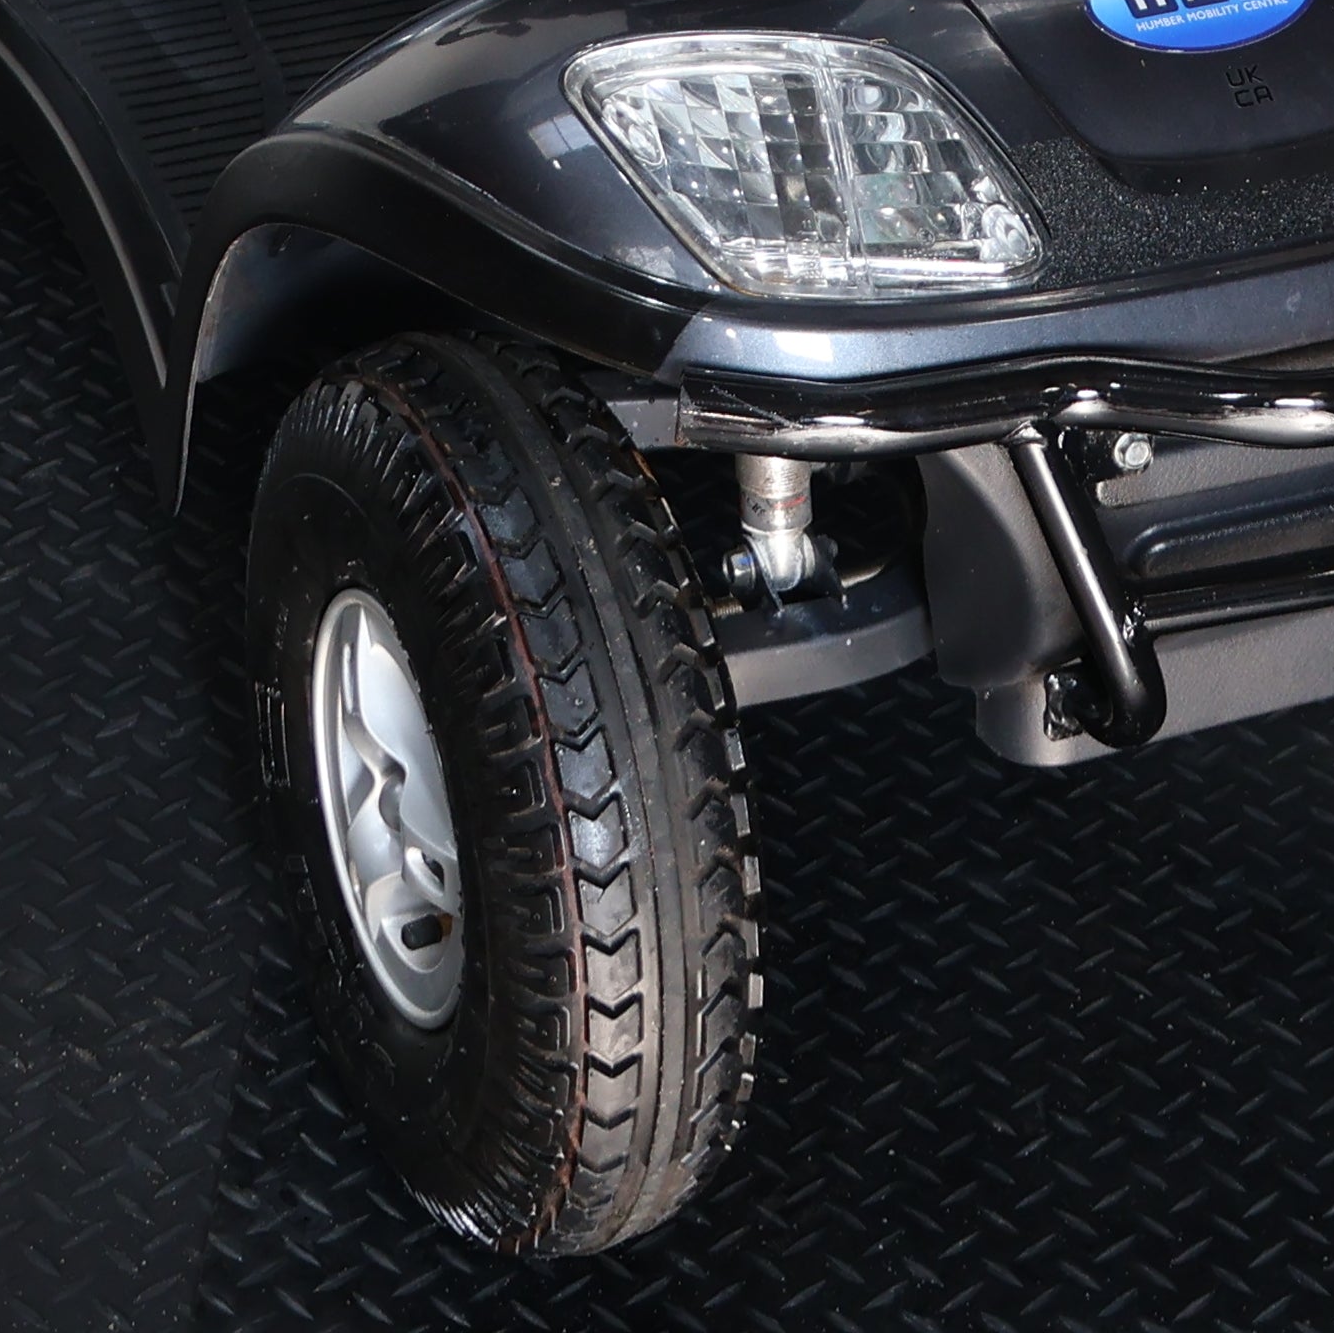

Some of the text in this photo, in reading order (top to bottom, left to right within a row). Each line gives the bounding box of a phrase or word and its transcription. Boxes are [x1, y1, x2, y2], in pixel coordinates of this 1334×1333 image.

[1135, 15, 1185, 33] HUMBER
[1186, 3, 1241, 23] MOBILITY
[1225, 64, 1264, 89] UK
[1233, 84, 1275, 109] CA
